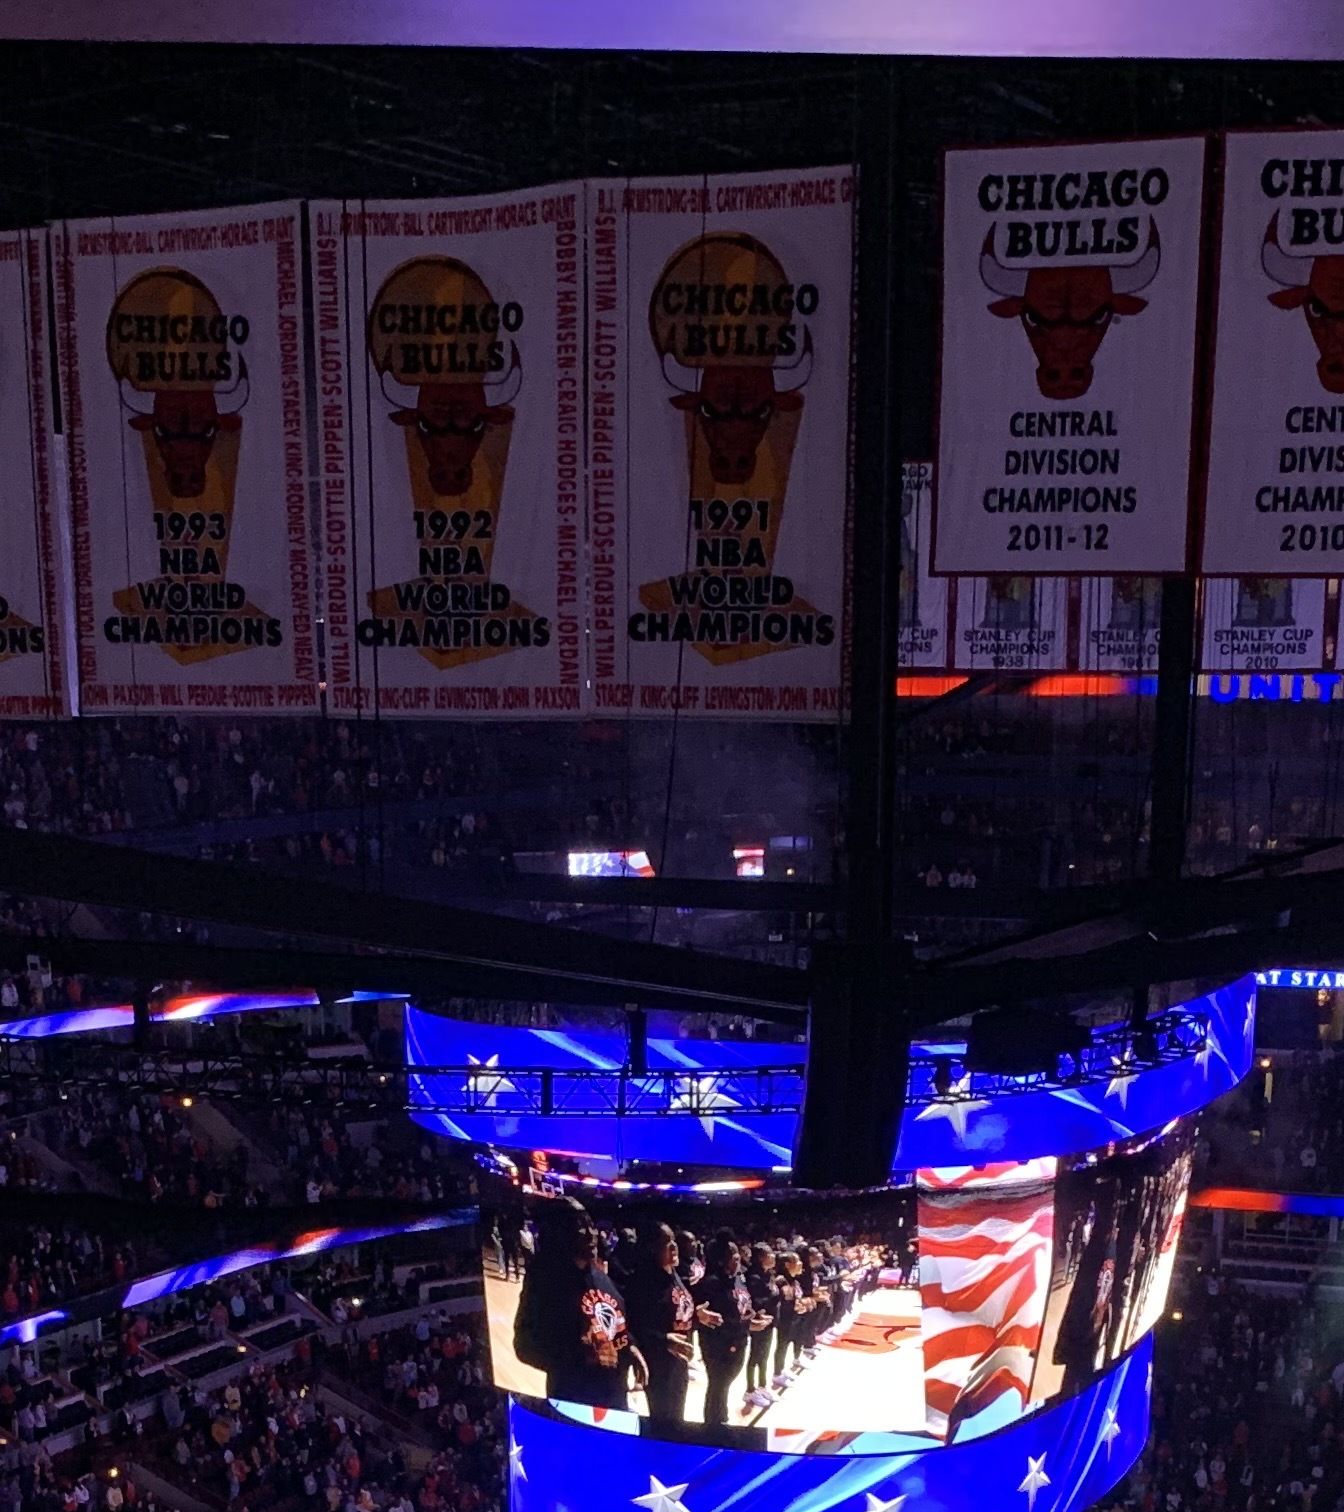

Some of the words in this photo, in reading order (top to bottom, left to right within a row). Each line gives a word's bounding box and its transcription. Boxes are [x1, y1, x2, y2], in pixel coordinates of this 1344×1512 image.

[978, 167, 1169, 212] CHICAGO
[556, 220, 577, 284] BOBBY
[1006, 216, 1138, 257] BULLS
[277, 241, 296, 309] MICHAEL
[595, 217, 616, 312] WILLIAMS
[317, 238, 338, 331] WILLIAMS
[662, 283, 818, 318] CHICAGO
[117, 313, 249, 346] CHICAGO
[378, 301, 524, 336] CHICAGO
[556, 290, 577, 369] HANSEN
[402, 339, 504, 374] BULLS
[594, 319, 616, 381] SCOTT
[683, 323, 797, 358] BULLS
[136, 351, 231, 382] BULLS
[320, 335, 341, 396] SCOTT
[557, 379, 577, 434] CRAIG
[323, 404, 346, 474] PIPPEN
[593, 391, 614, 463] PIPPEN
[1009, 411, 1117, 438] CENTRAL
[557, 439, 577, 514] HODGES
[1005, 448, 1119, 475] DIVISION
[593, 469, 614, 548] SCOTTIE
[689, 500, 768, 531] 1991
[982, 486, 1137, 512] CHAMPIONS
[153, 511, 226, 540] 1993
[325, 479, 346, 556] SCOTTIE
[413, 509, 492, 540] 1992
[160, 546, 221, 576] NBA
[419, 545, 485, 576] NBA
[557, 525, 577, 607] MICHAEL
[697, 536, 765, 567] NBA
[136, 581, 245, 611] WORLD
[328, 563, 348, 637] PERDUE
[394, 580, 510, 612] WORLD
[594, 553, 615, 630] PERDUE
[669, 574, 794, 607] WORLD
[104, 615, 282, 647] CHAMPIONS
[357, 615, 551, 647] CHAMPIONS
[628, 613, 835, 646] CHAMPIONS
[964, 629, 1022, 641] STANLEY
[1091, 629, 1149, 641] STANLEY
[1214, 628, 1277, 642] STANLEY
[1282, 628, 1314, 641] CUP
[331, 642, 351, 684] WILL
[558, 612, 579, 685] JORDAN
[595, 635, 615, 678] WILL
[970, 643, 1050, 655] CHAMPIONS
[1097, 643, 1156, 656] CHAMPIO
[1219, 642, 1307, 656] CHAMPIONS
[1246, 656, 1279, 669] 2010
